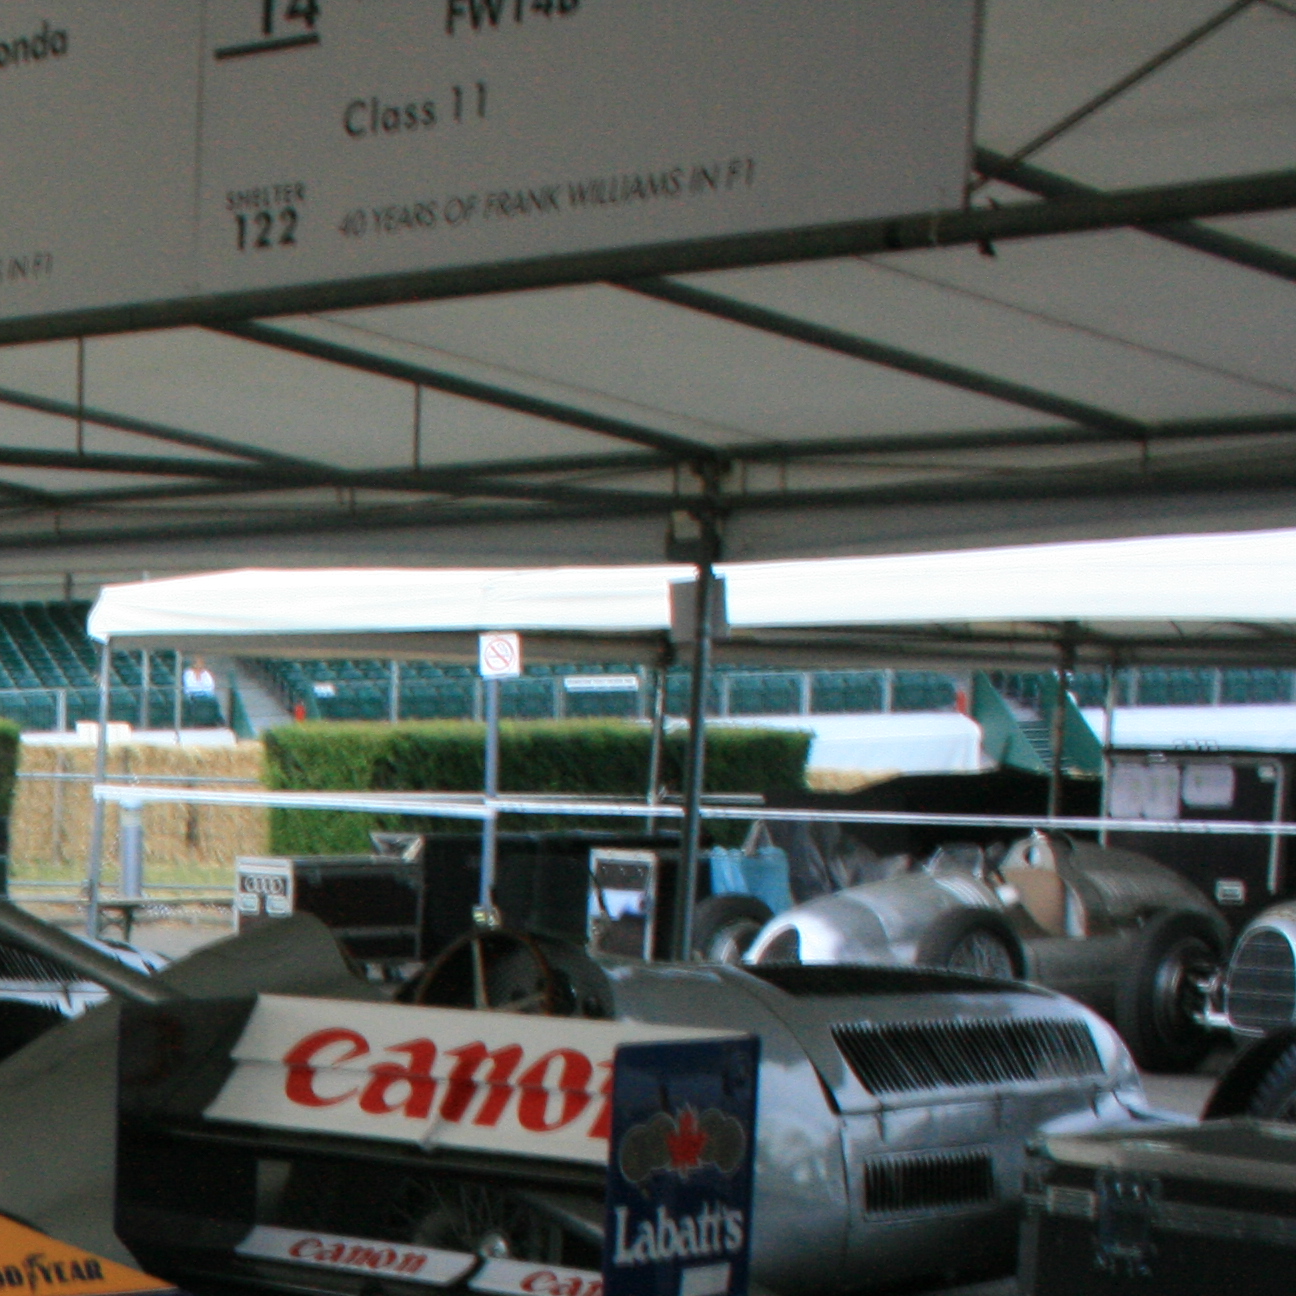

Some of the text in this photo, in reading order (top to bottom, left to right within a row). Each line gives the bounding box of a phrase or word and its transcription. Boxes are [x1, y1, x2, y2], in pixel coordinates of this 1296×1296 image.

[344, 80, 487, 139] Class 11
[226, 182, 306, 213] SHELTER
[338, 158, 755, 238] 40 YEARS OF FRANK WILLIAMS IN F1
[233, 206, 300, 252] 122
[9, 253, 29, 280] IN
[283, 1026, 610, 1140] Cano
[613, 1203, 746, 1265] Labatt's
